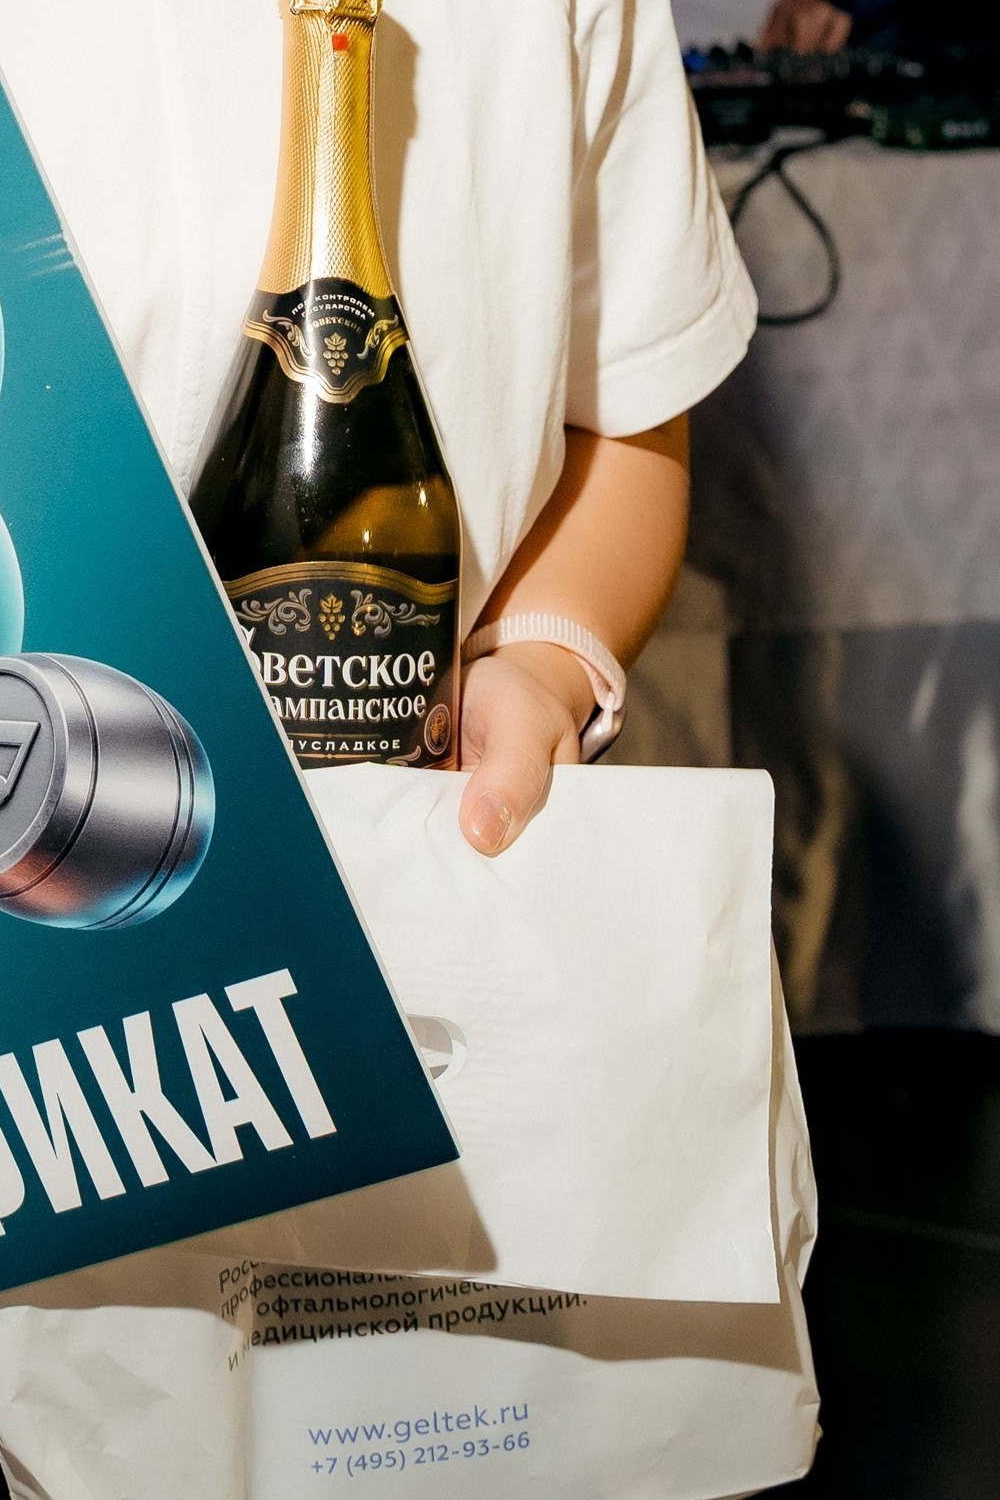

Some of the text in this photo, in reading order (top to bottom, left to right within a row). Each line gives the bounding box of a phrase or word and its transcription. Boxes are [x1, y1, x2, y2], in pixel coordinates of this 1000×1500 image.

[306, 316, 362, 334] ОВЕТСКОЕ
[315, 294, 376, 318] КОНТРОЛЕМ
[241, 626, 436, 688] ветское
[269, 694, 428, 722] ампанское
[228, 1351, 239, 1372] и
[428, 1293, 587, 1333] продукции.
[308, 1403, 529, 1444] www.geltek.ru
[311, 1431, 530, 1477] +7 (495) 212-93-66
